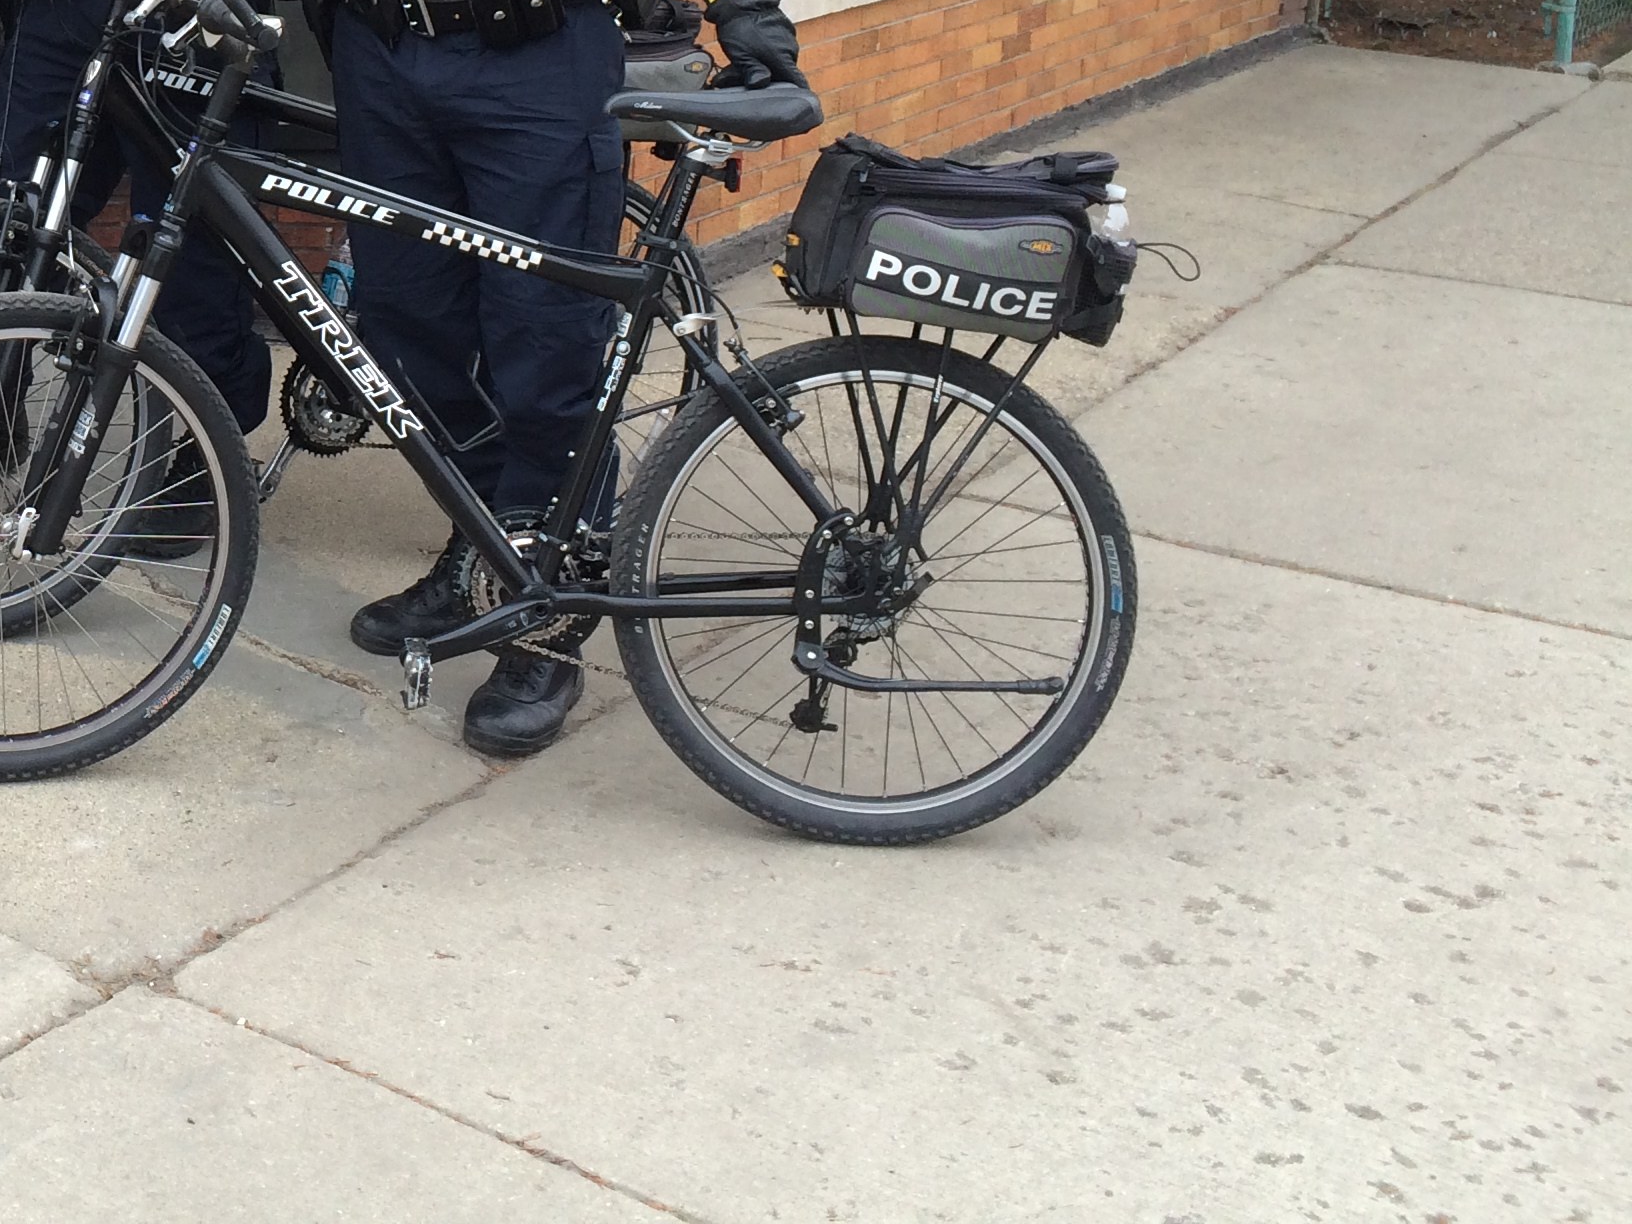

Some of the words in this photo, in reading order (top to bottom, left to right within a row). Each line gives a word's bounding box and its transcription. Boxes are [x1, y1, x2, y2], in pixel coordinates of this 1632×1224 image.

[144, 67, 215, 97] POLI
[261, 174, 400, 226] POLICE
[671, 172, 698, 228] BONTRAGER
[866, 250, 1058, 320] POLICE
[273, 260, 424, 439] TREK
